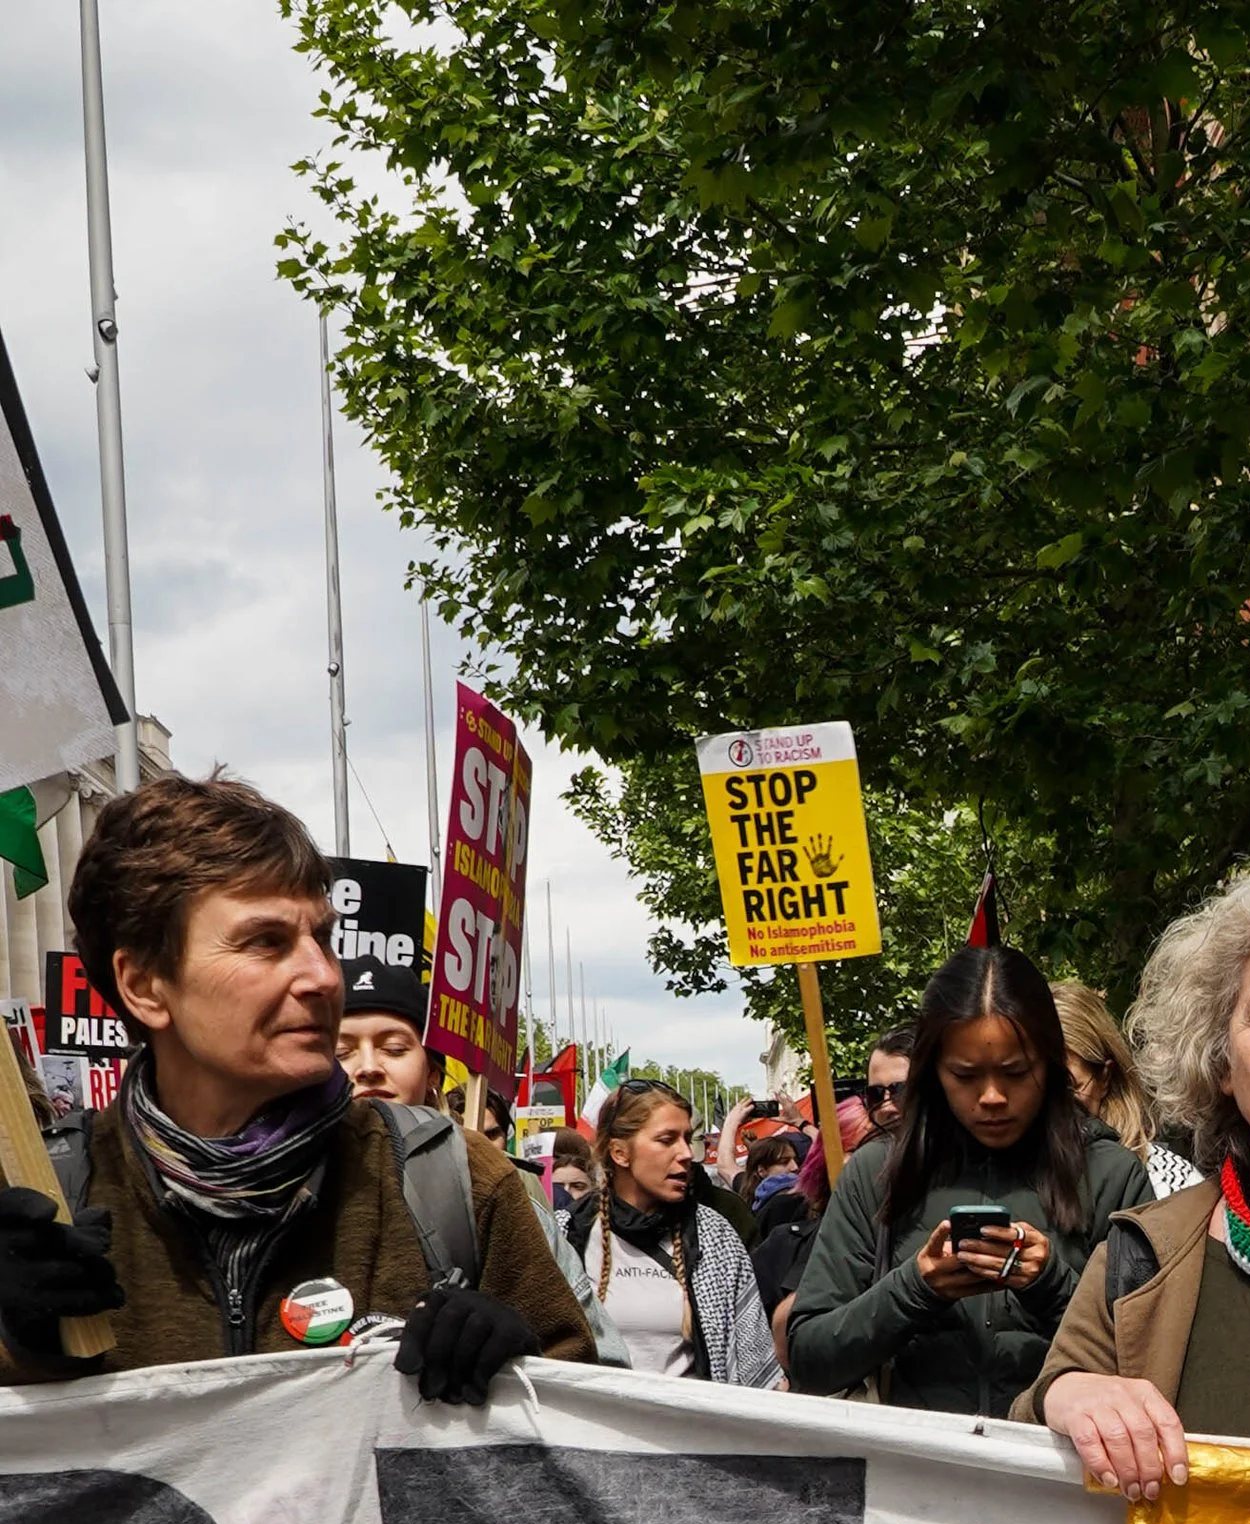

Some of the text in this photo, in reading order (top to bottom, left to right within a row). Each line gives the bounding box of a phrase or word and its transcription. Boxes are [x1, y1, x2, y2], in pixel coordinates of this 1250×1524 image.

[477, 718, 501, 753] STAND
[754, 734, 814, 751] STAND UP
[757, 746, 823, 765] TO RACISM
[725, 770, 817, 811] STOP
[459, 747, 526, 883] STP
[730, 810, 798, 848] THE
[737, 849, 800, 886] FAR
[742, 881, 849, 923] RIGHT
[747, 920, 856, 941] No Islamophobia
[750, 938, 857, 958] No antisemitism
[439, 993, 469, 1039] THE
[470, 1011, 493, 1053] FAR
